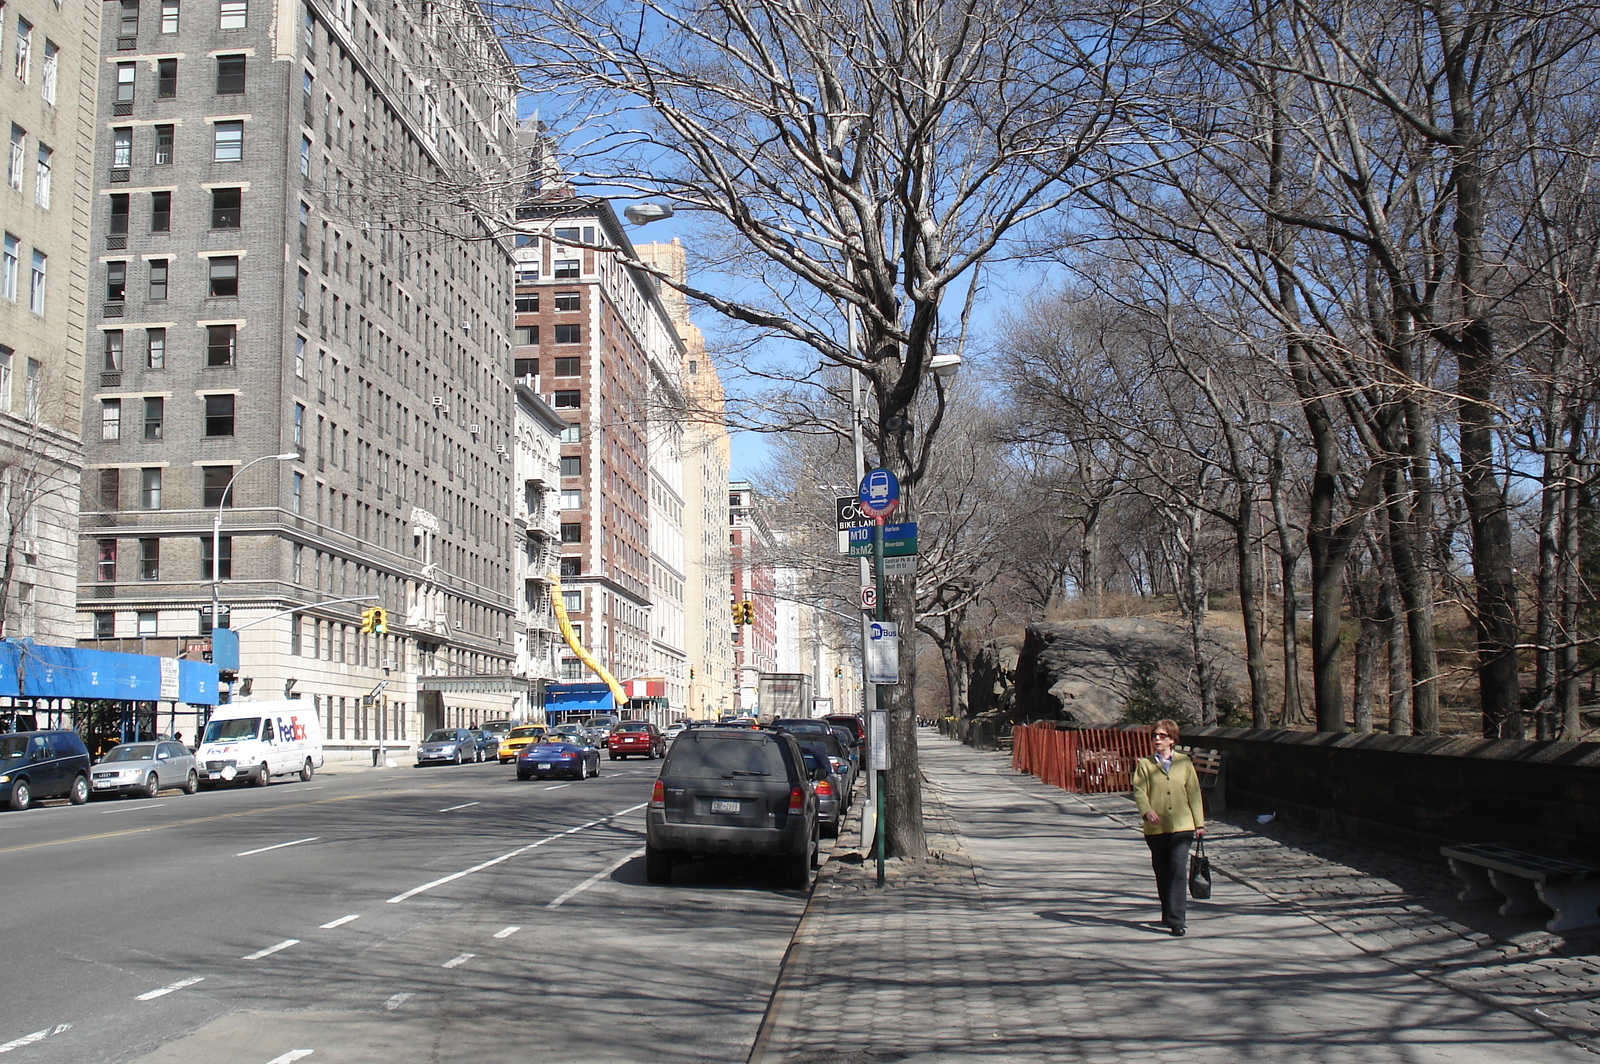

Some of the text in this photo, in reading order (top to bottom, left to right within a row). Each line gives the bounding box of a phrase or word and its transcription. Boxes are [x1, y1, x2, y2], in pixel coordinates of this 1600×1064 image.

[870, 503, 895, 516] STANDING
[839, 519, 876, 529] BIKE LAN
[850, 529, 868, 540] M10
[850, 544, 873, 555] BxM2
[883, 629, 897, 637] Bus
[277, 716, 307, 742] FedEx
[207, 746, 239, 755] FedEx
